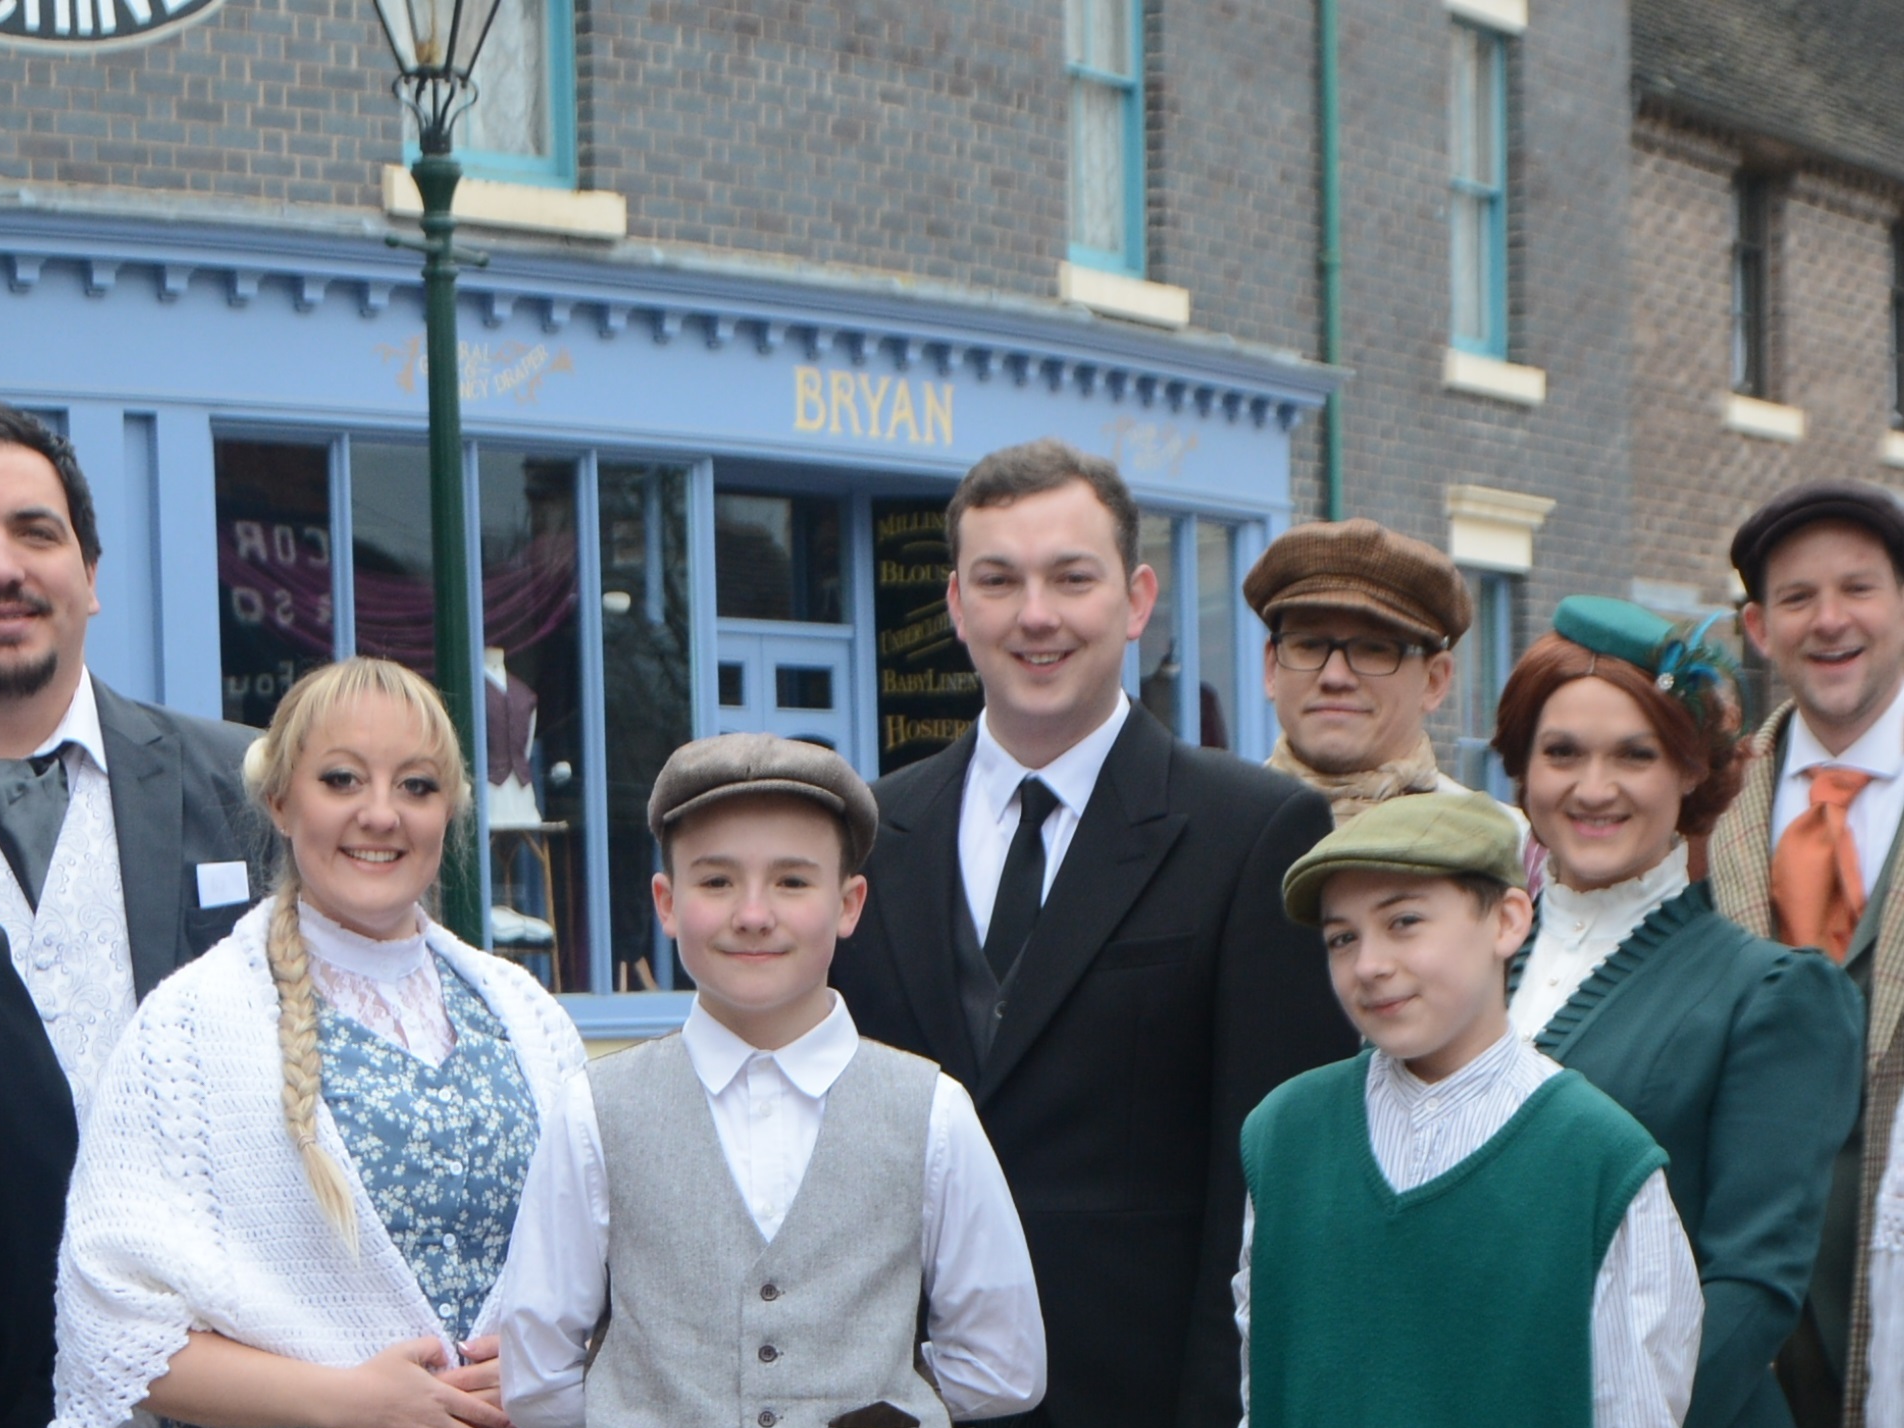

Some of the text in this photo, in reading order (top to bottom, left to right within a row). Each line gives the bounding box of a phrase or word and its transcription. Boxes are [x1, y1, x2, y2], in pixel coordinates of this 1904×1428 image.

[496, 343, 549, 392] DRAPER
[794, 364, 956, 446] BRYAN
[879, 512, 946, 541] MILLIN
[880, 561, 951, 585] BLOUS
[884, 714, 972, 750] HOSIER
